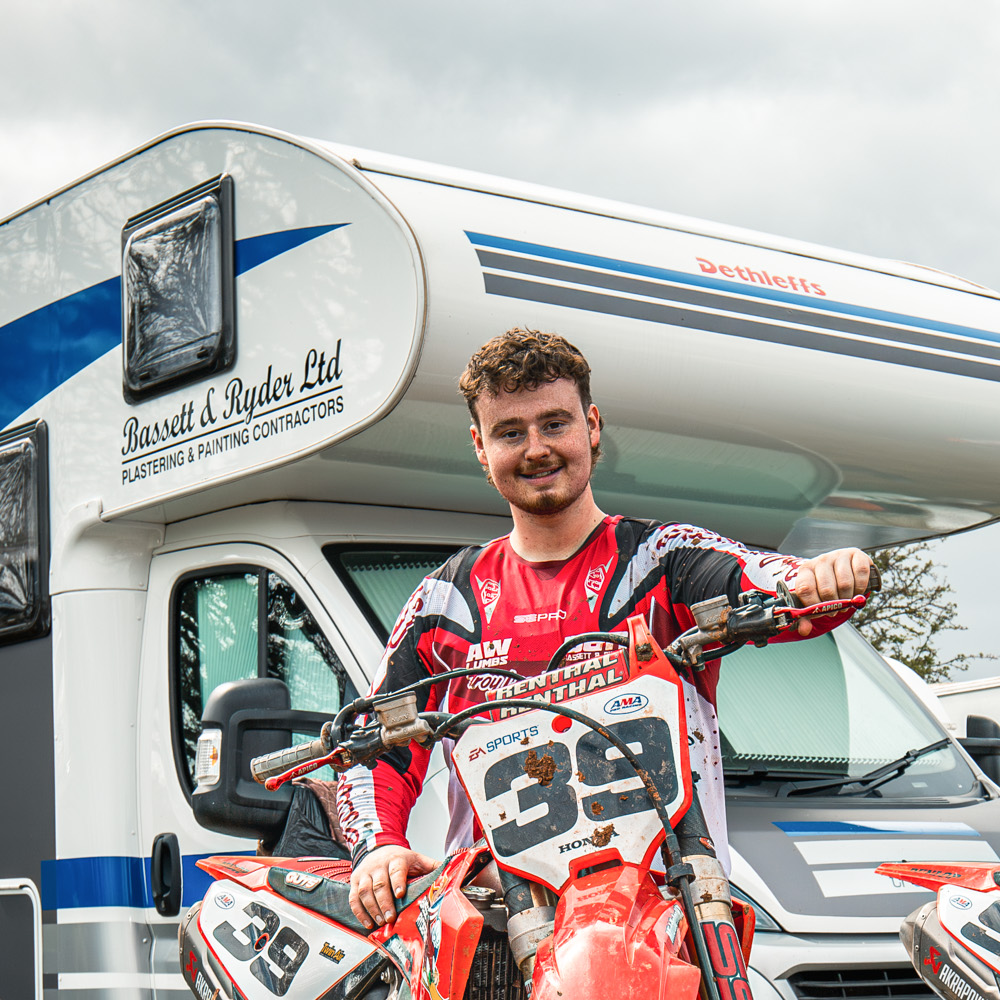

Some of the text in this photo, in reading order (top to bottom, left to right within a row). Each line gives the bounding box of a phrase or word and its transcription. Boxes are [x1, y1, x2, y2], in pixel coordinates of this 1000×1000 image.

[695, 257, 826, 296] Dethleffs
[122, 400, 195, 456] Bassett
[223, 364, 294, 424] Ryder
[299, 338, 343, 393] Ltd
[122, 395, 344, 485] PLASTERING & PAINTING CONTRACTORS
[821, 602, 843, 613] APICO
[466, 637, 513, 663] AW
[466, 655, 509, 671] LUMBS
[495, 650, 619, 701] RENTHAL
[609, 696, 642, 711] AMA
[486, 725, 540, 753] SPORTS
[484, 716, 679, 858] 39
[558, 830, 620, 854] HONA
[212, 901, 311, 998] 39
